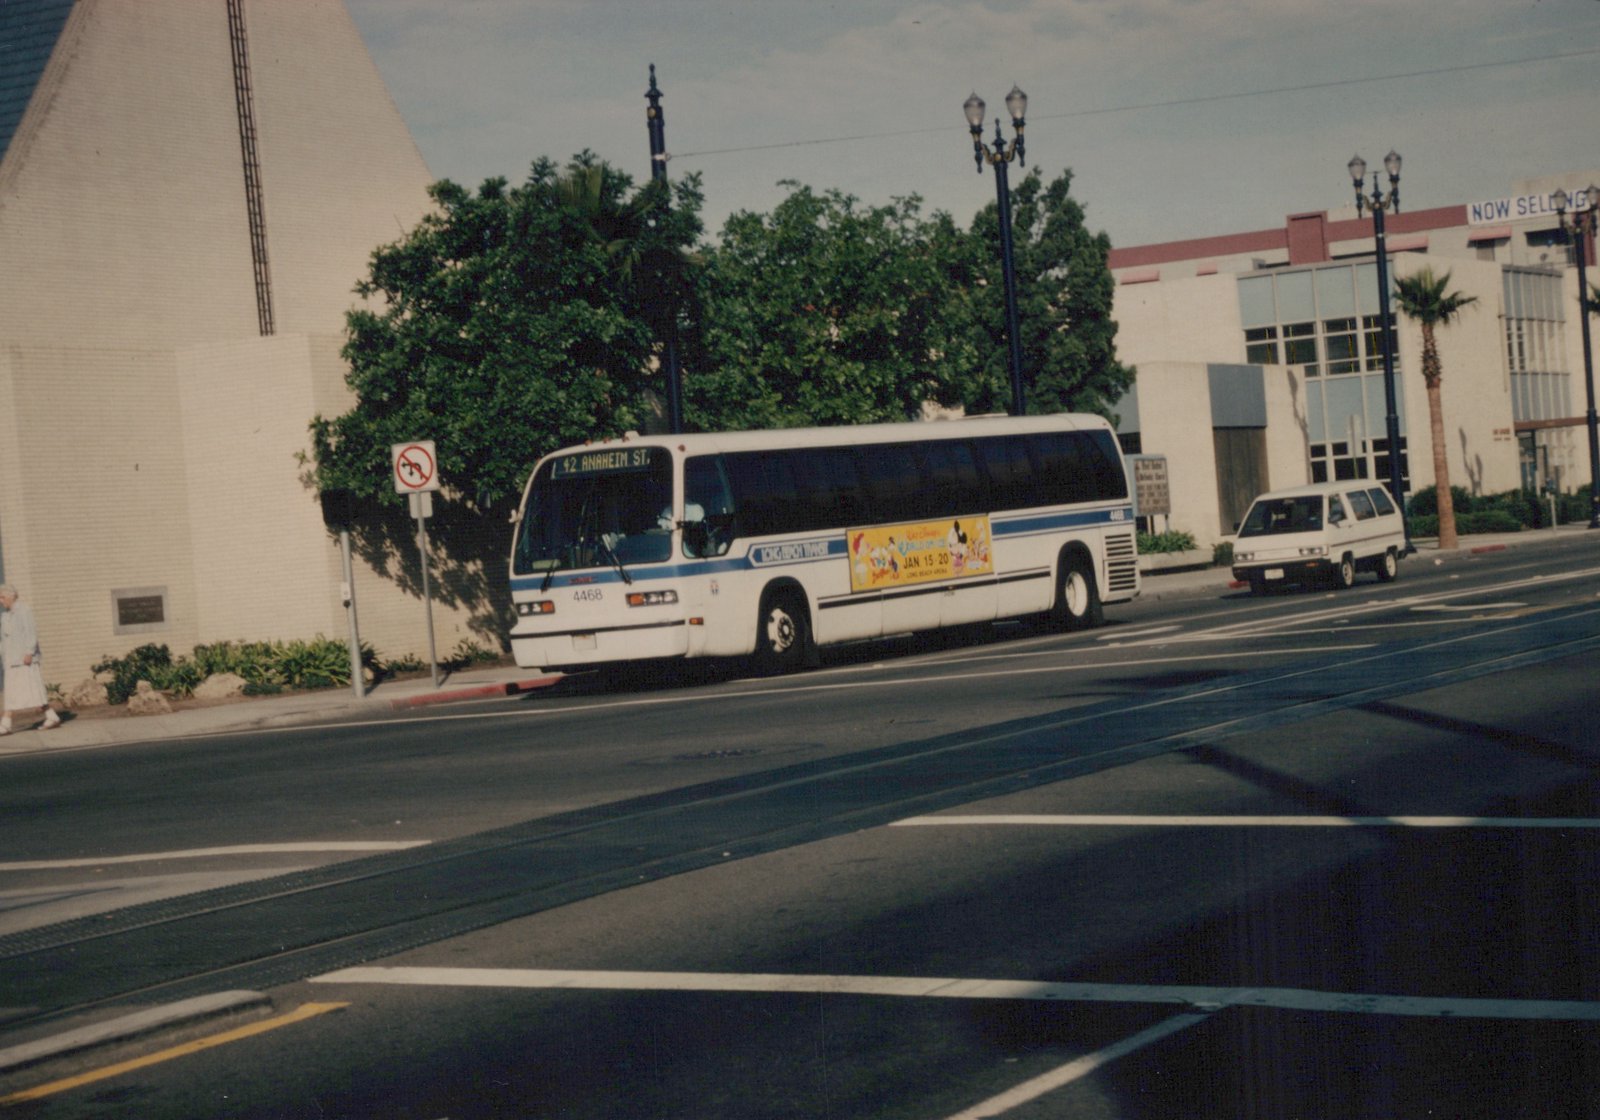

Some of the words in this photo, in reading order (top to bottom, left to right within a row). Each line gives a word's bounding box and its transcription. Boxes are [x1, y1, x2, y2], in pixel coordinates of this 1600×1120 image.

[1472, 199, 1510, 221] NOW
[1517, 190, 1587, 216] SELLNG
[581, 451, 628, 471] ANAHEIM
[903, 556, 920, 570] JAN
[573, 588, 603, 602] 4468
